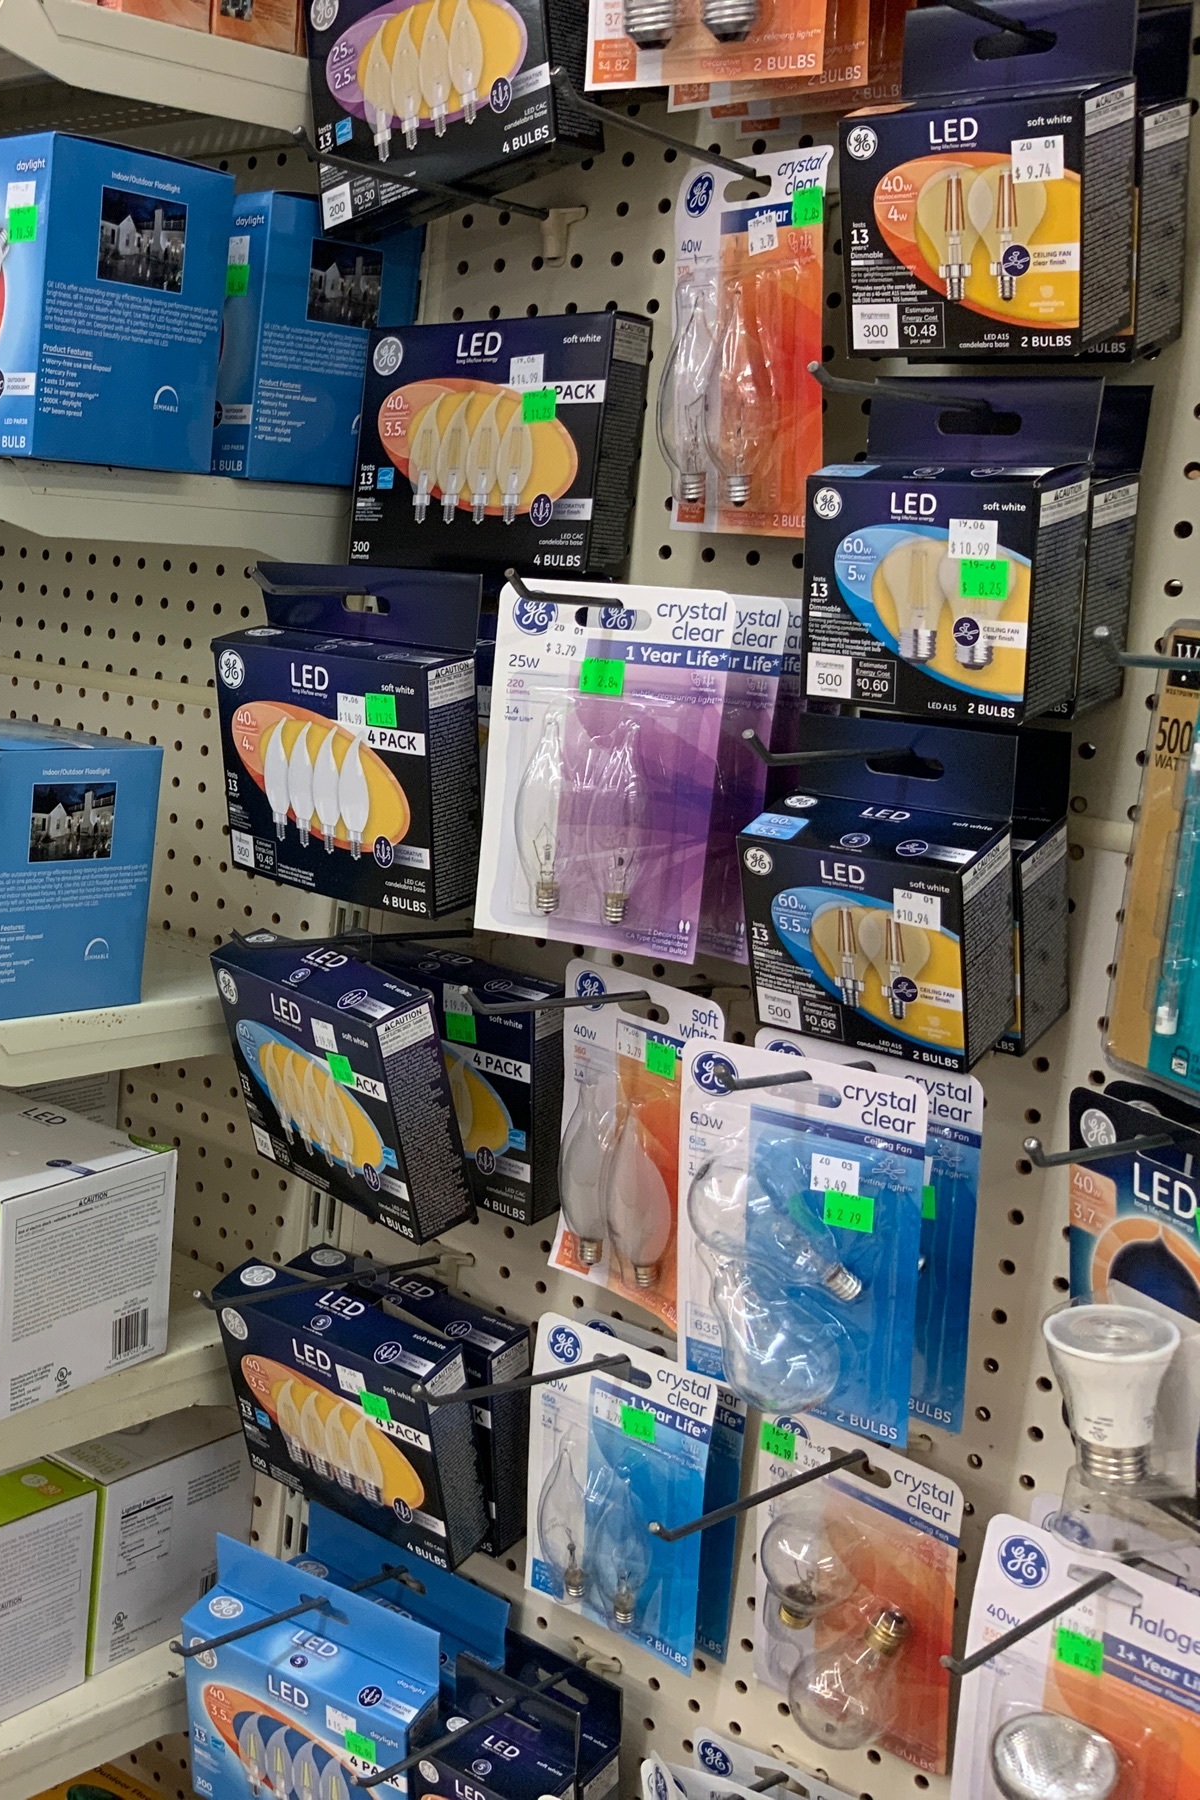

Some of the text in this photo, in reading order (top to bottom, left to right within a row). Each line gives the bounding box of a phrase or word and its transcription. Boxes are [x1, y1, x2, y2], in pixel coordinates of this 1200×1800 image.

[598, 59, 630, 71] $4.82
[753, 53, 816, 72] 2 BULBS
[820, 66, 861, 84] BULBS
[524, 105, 535, 116] LED
[929, 117, 978, 144] LED
[1027, 115, 1072, 127] soft white
[319, 133, 332, 149] 13
[502, 126, 549, 153] 4 BULBS
[1044, 140, 1055, 149] 01
[16, 159, 45, 172] daylight
[778, 152, 827, 179] crystal
[1027, 164, 1051, 179] 9.74
[111, 171, 180, 194] Indoor/Outdoor Floodlight
[353, 190, 375, 206] $0.30
[329, 202, 346, 218] 200
[236, 214, 264, 226] daylight
[851, 229, 868, 244] 13
[1033, 250, 1071, 259] CEILING FAN
[563, 334, 601, 344] soft white
[863, 325, 888, 337] 300
[903, 325, 937, 337] $0.48
[43, 344, 93, 358] Product Features:
[456, 332, 502, 358] LED
[1021, 336, 1071, 347] 2 BULBS
[554, 384, 596, 400] PACK
[153, 403, 178, 412] DIMMABLE
[2, 435, 26, 448] BULB
[219, 459, 243, 472] BULB
[360, 472, 373, 485] 13
[890, 492, 937, 516] LED
[983, 502, 1026, 512] soft white
[351, 552, 370, 560] lumens
[352, 541, 370, 552] 300
[534, 554, 580, 566] 4 BULBS
[811, 583, 828, 597] 13
[656, 601, 728, 624] crystal
[672, 622, 724, 643] clear
[732, 629, 778, 649] clear
[625, 645, 634, 660] 1
[641, 647, 681, 666] Year
[291, 662, 329, 690] LED
[440, 662, 469, 677] CAUTION
[817, 673, 842, 686] 500
[857, 678, 888, 691] $0.60
[381, 684, 414, 695] soft white
[968, 703, 1015, 718] 2 BULBS
[368, 730, 417, 751] 4 PACK
[1156, 715, 1193, 753] 500
[861, 806, 911, 821] LED
[820, 860, 865, 885] LED
[383, 894, 427, 913] 4 BULBS
[270, 992, 302, 1025] LED
[389, 1008, 423, 1030] CAUTION
[692, 1008, 718, 1029] soft
[473, 1052, 523, 1078] 4 PACK
[913, 1051, 959, 1069] 2 BULBS
[842, 1084, 917, 1114] crystal
[861, 1109, 916, 1135] clear
[864, 1135, 913, 1155] Ceiling Fan
[1133, 1162, 1197, 1220] LED
[318, 1291, 365, 1317] LED
[292, 1338, 331, 1371] LED
[656, 1368, 713, 1400] crystal
[667, 1391, 708, 1417] clear
[386, 1421, 423, 1446] PACK
[836, 1410, 898, 1440] 2 BULBS
[893, 1469, 955, 1508] crystal
[907, 1491, 952, 1524] clear
[291, 1629, 338, 1660] LED
[645, 1637, 688, 1668] 2 BULBS
[1118, 1645, 1179, 1679] 1+ Year
[267, 1674, 309, 1710] LED
[370, 1730, 398, 1749] daylight
